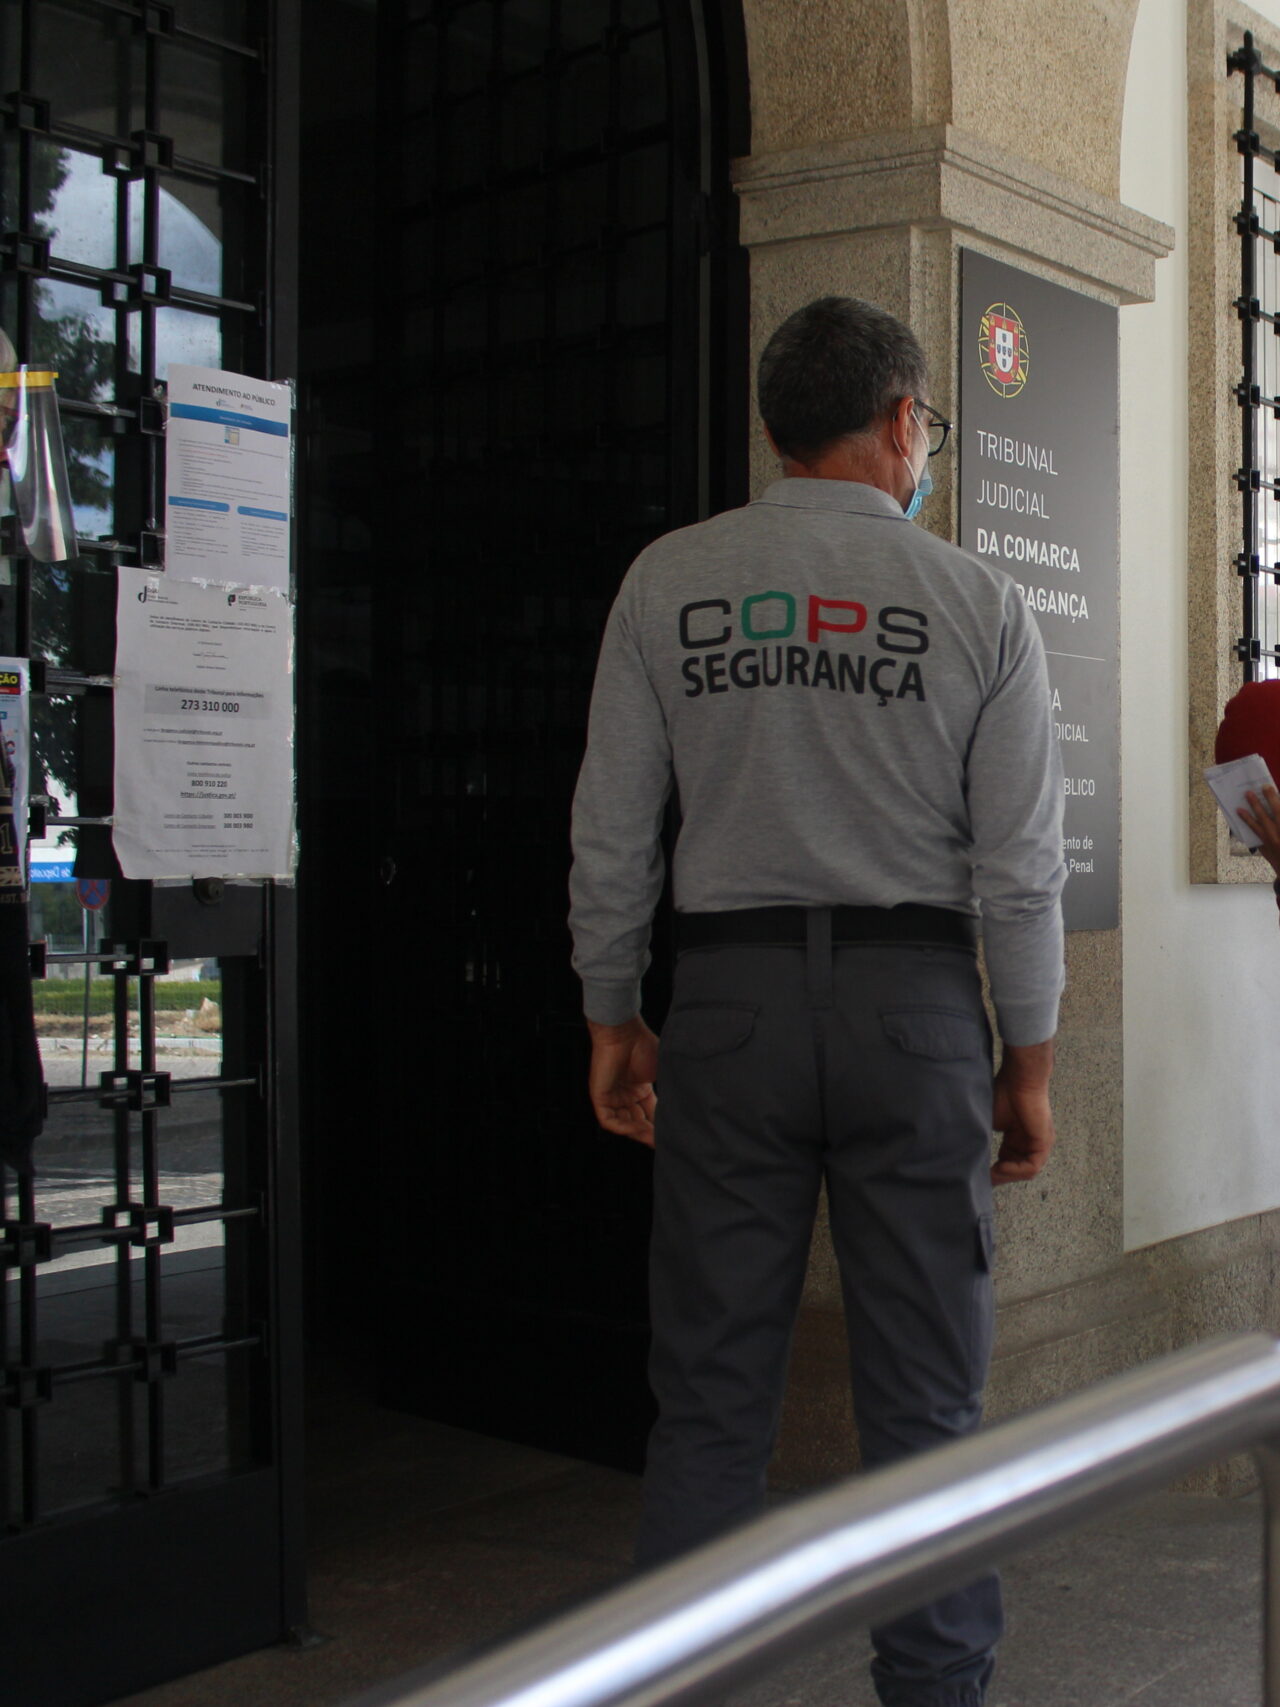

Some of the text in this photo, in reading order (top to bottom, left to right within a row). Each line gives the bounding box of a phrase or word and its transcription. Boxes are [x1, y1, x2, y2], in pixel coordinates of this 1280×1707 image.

[192, 383, 276, 406] ATENDIMENTO AO PÚBLICO
[977, 430, 1058, 475] TRIBUNAL
[977, 479, 1050, 519] JUDICIAL
[977, 527, 1080, 572] DA COMARCA
[679, 590, 929, 655] COPS
[681, 645, 926, 707] SEGURANÇA
[181, 699, 240, 713] 273 310 000
[1082, 835, 1094, 850] de
[1069, 859, 1094, 873] Penal
